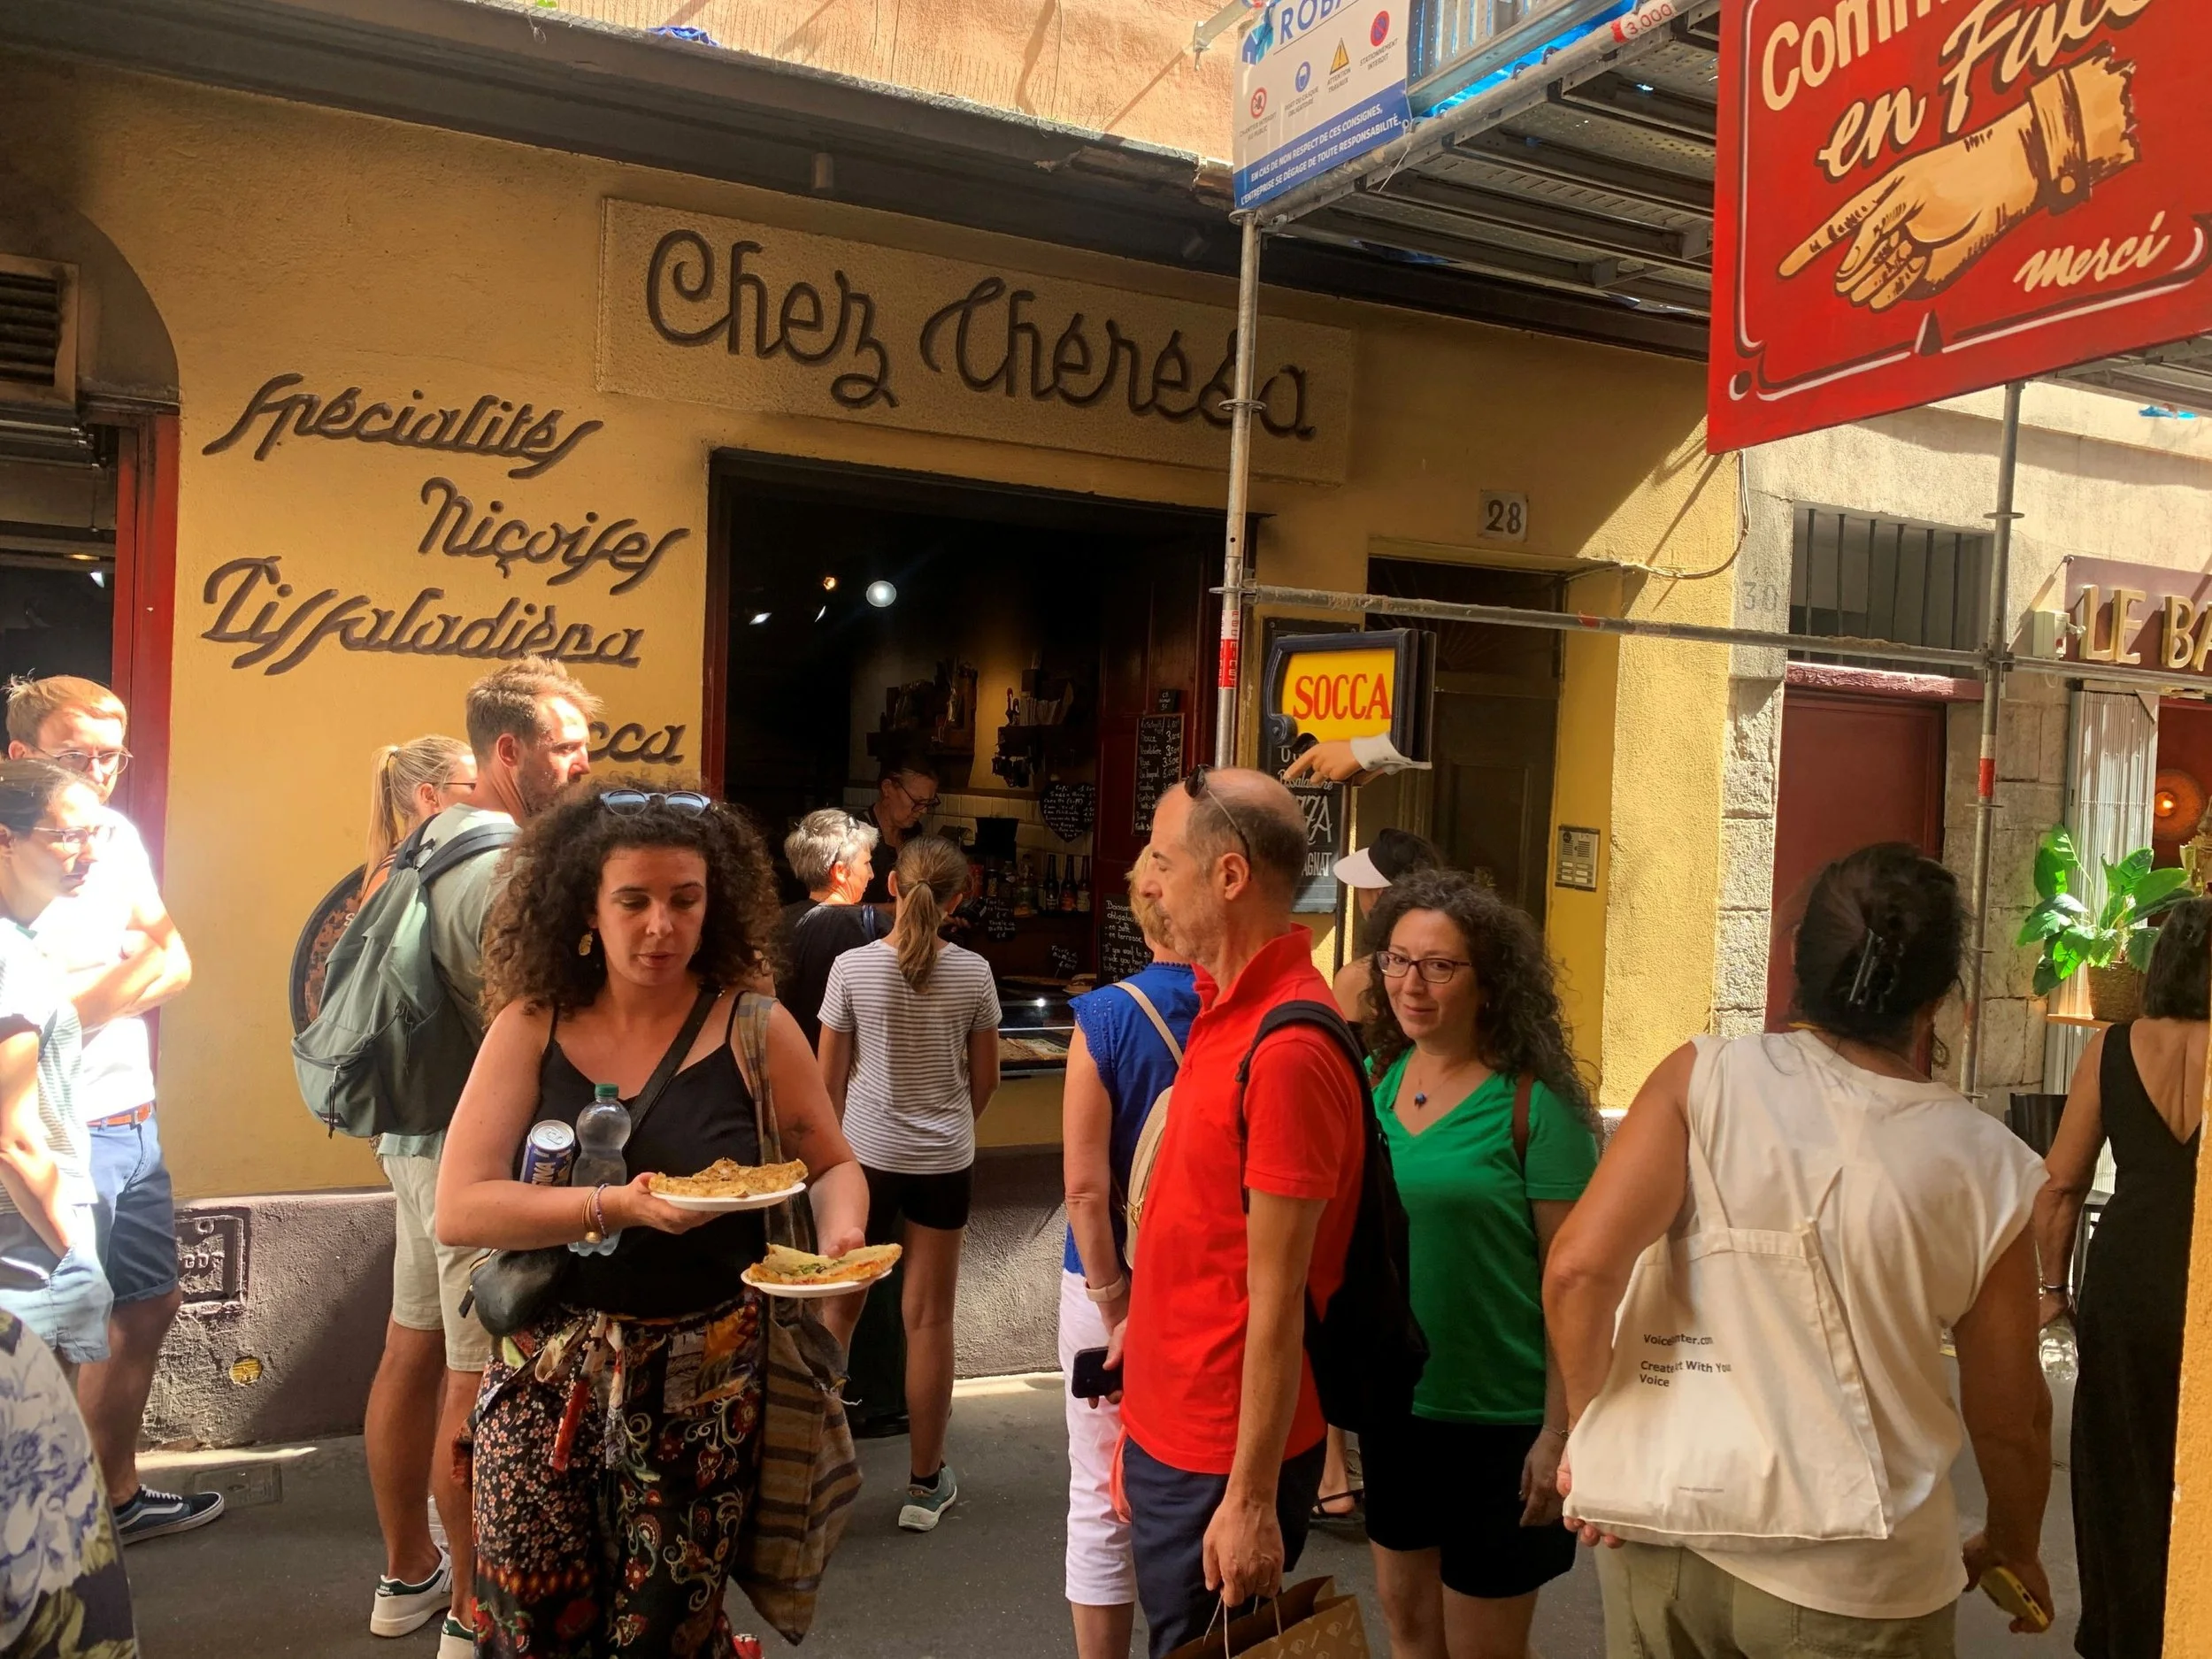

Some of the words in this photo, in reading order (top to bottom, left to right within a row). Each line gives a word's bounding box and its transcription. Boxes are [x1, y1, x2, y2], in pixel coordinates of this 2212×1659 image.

[1360, 37, 1398, 66] STATIONNEMENT
[1367, 52, 1389, 71] INTERDIT
[1327, 67, 1351, 86] ATTENTION
[1251, 172, 1259, 182] EN
[1259, 165, 1270, 177] CAS
[1270, 159, 1279, 171] DE
[1279, 151, 1292, 167] NON
[1292, 136, 1319, 159] RESPECT
[1319, 132, 1329, 144] DE
[1329, 124, 1341, 138] CES
[1341, 104, 1383, 132] CONSIGNES,
[1817, 86, 1927, 177] en
[1240, 179, 1274, 205] L'ENTREPRISE
[1275, 173, 1283, 186] SE
[1283, 161, 1307, 181] DÉGAGE
[1307, 156, 1317, 168] DE
[1317, 144, 1338, 163] TOUTE
[1339, 112, 1402, 152] RESPONSABILITÉ.
[646, 228, 900, 409] Chez
[420, 477, 691, 595] Niçoises
[1486, 499, 1522, 534] 28
[2079, 584, 2147, 664] LE
[1293, 672, 1392, 720] SOCCA
[587, 720, 687, 765] cca
[1639, 1373, 1670, 1387] Voice
[1686, 1360, 1713, 1373] With
